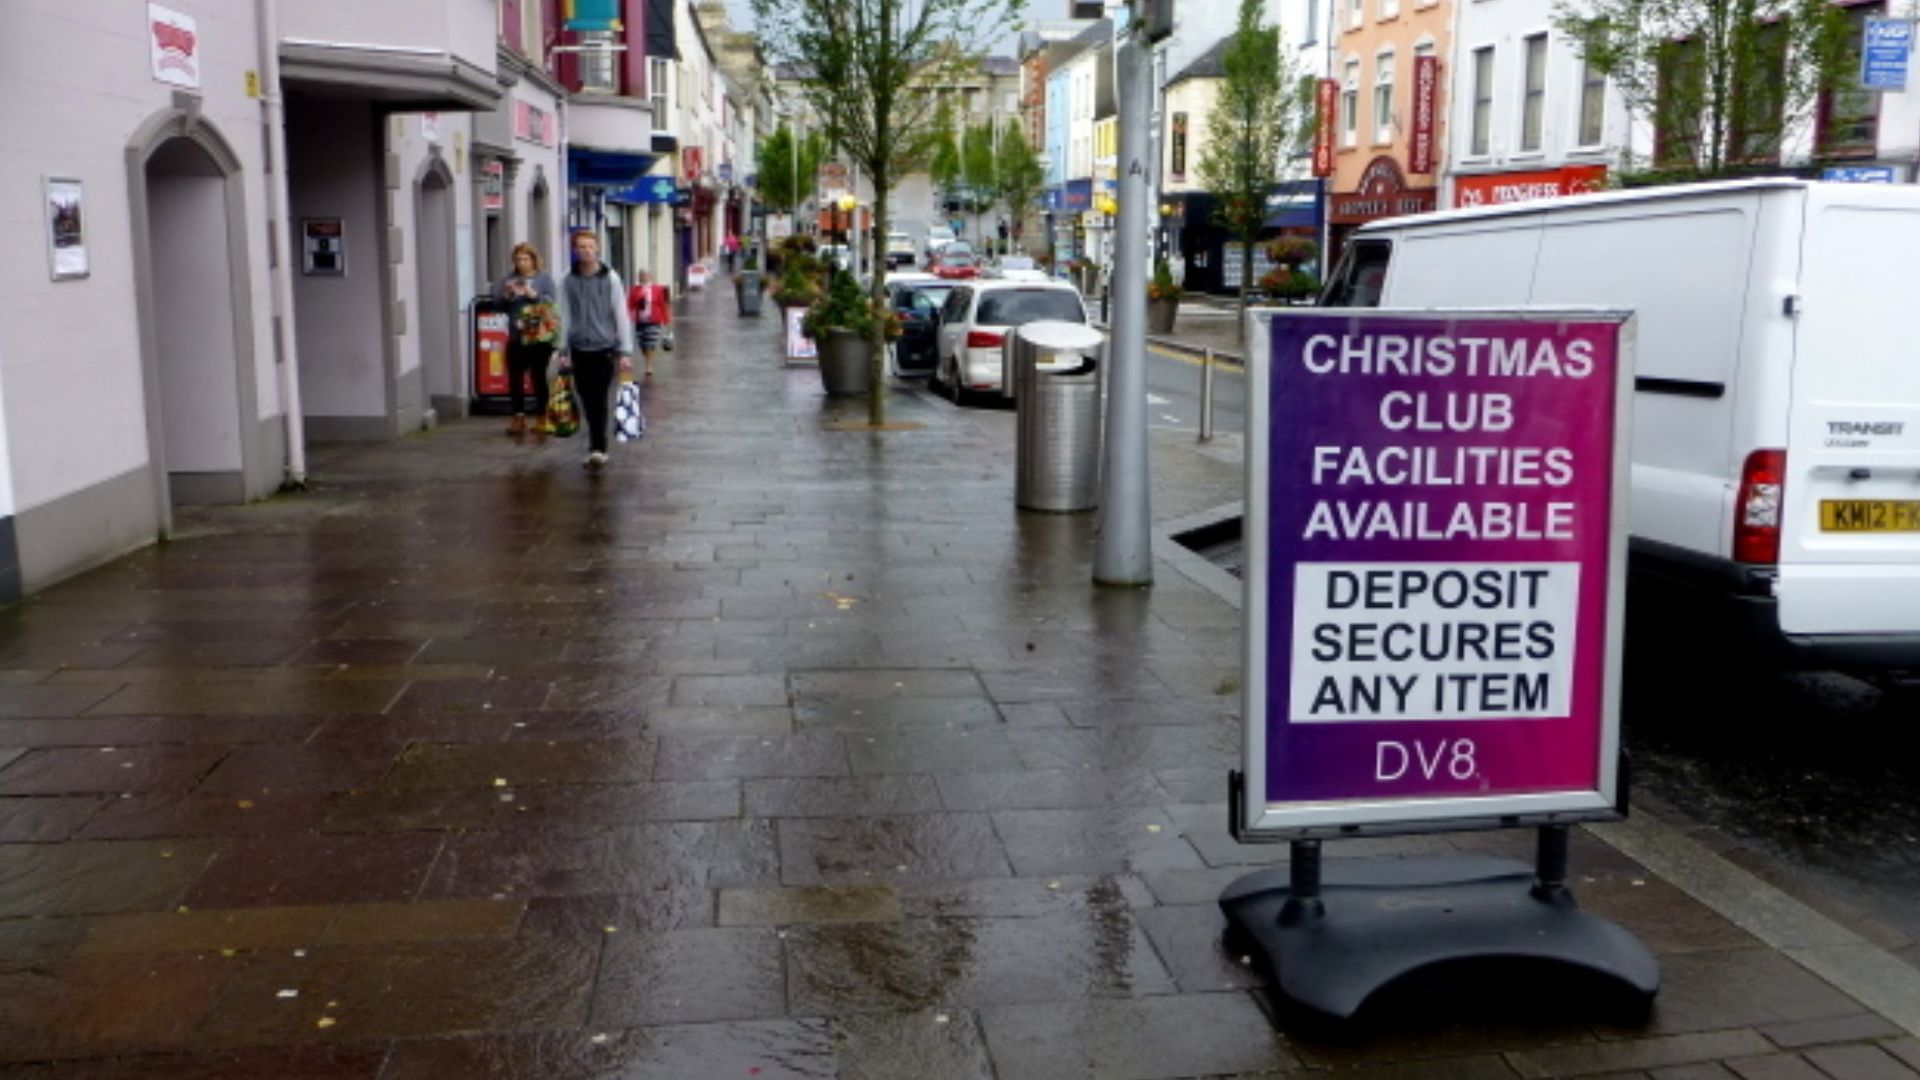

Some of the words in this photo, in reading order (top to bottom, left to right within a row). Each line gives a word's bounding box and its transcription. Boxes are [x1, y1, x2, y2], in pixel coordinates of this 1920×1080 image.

[1303, 334, 1593, 378] CHRISTMAS
[1380, 391, 1514, 432] CLUB
[1826, 420, 1905, 436] TRANSIT
[1313, 446, 1573, 486] FACILITIES
[1303, 501, 1574, 540] AVAILABLE
[1834, 501, 1887, 528] KM12
[1326, 569, 1549, 610] DEPOSIT
[1311, 620, 1555, 662] SECURES
[1310, 675, 1418, 715] ANY
[1434, 672, 1549, 712] ITEM
